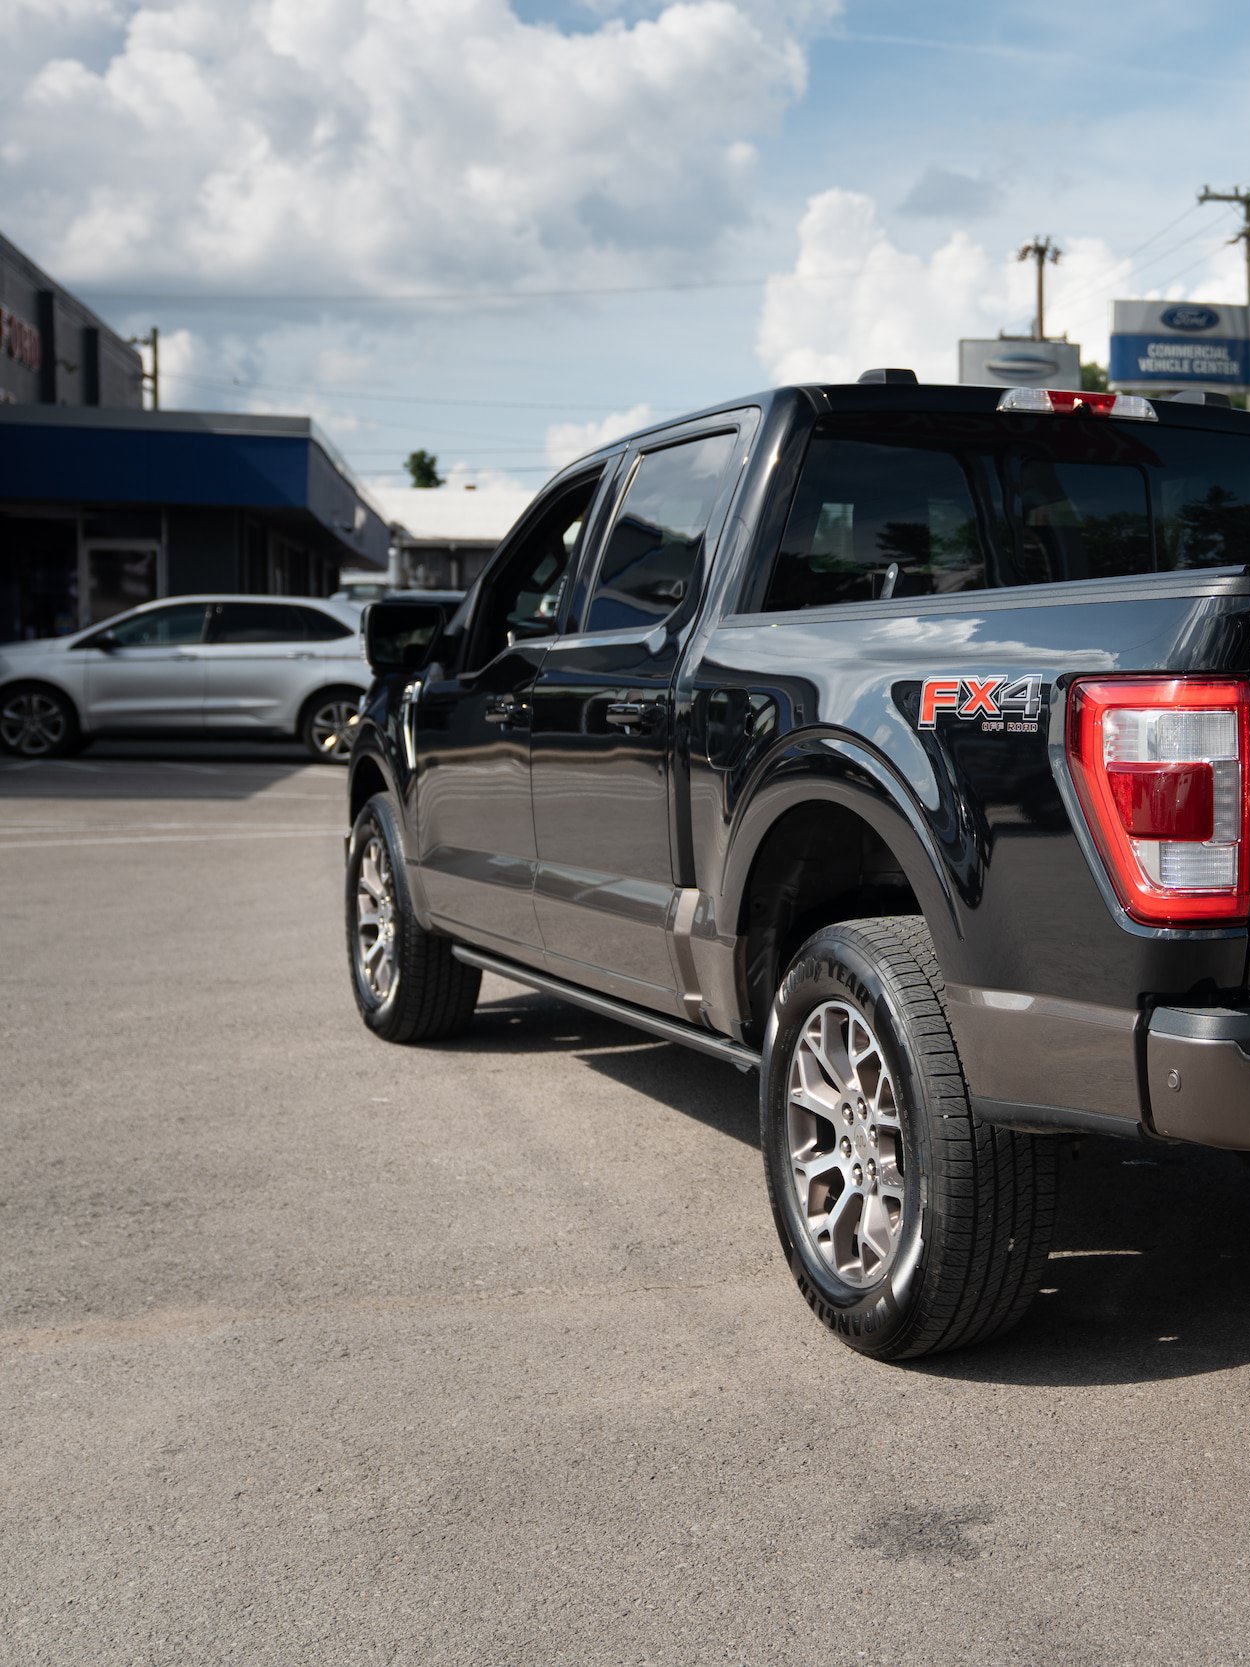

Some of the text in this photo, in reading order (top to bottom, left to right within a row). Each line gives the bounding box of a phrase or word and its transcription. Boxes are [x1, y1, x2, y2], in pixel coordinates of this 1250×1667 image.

[1148, 343, 1229, 360] COMMERCIAL
[1138, 358, 1239, 375] VEHICLE CENTER
[917, 673, 1043, 730] FX4
[982, 721, 1038, 732] OFF ROAD
